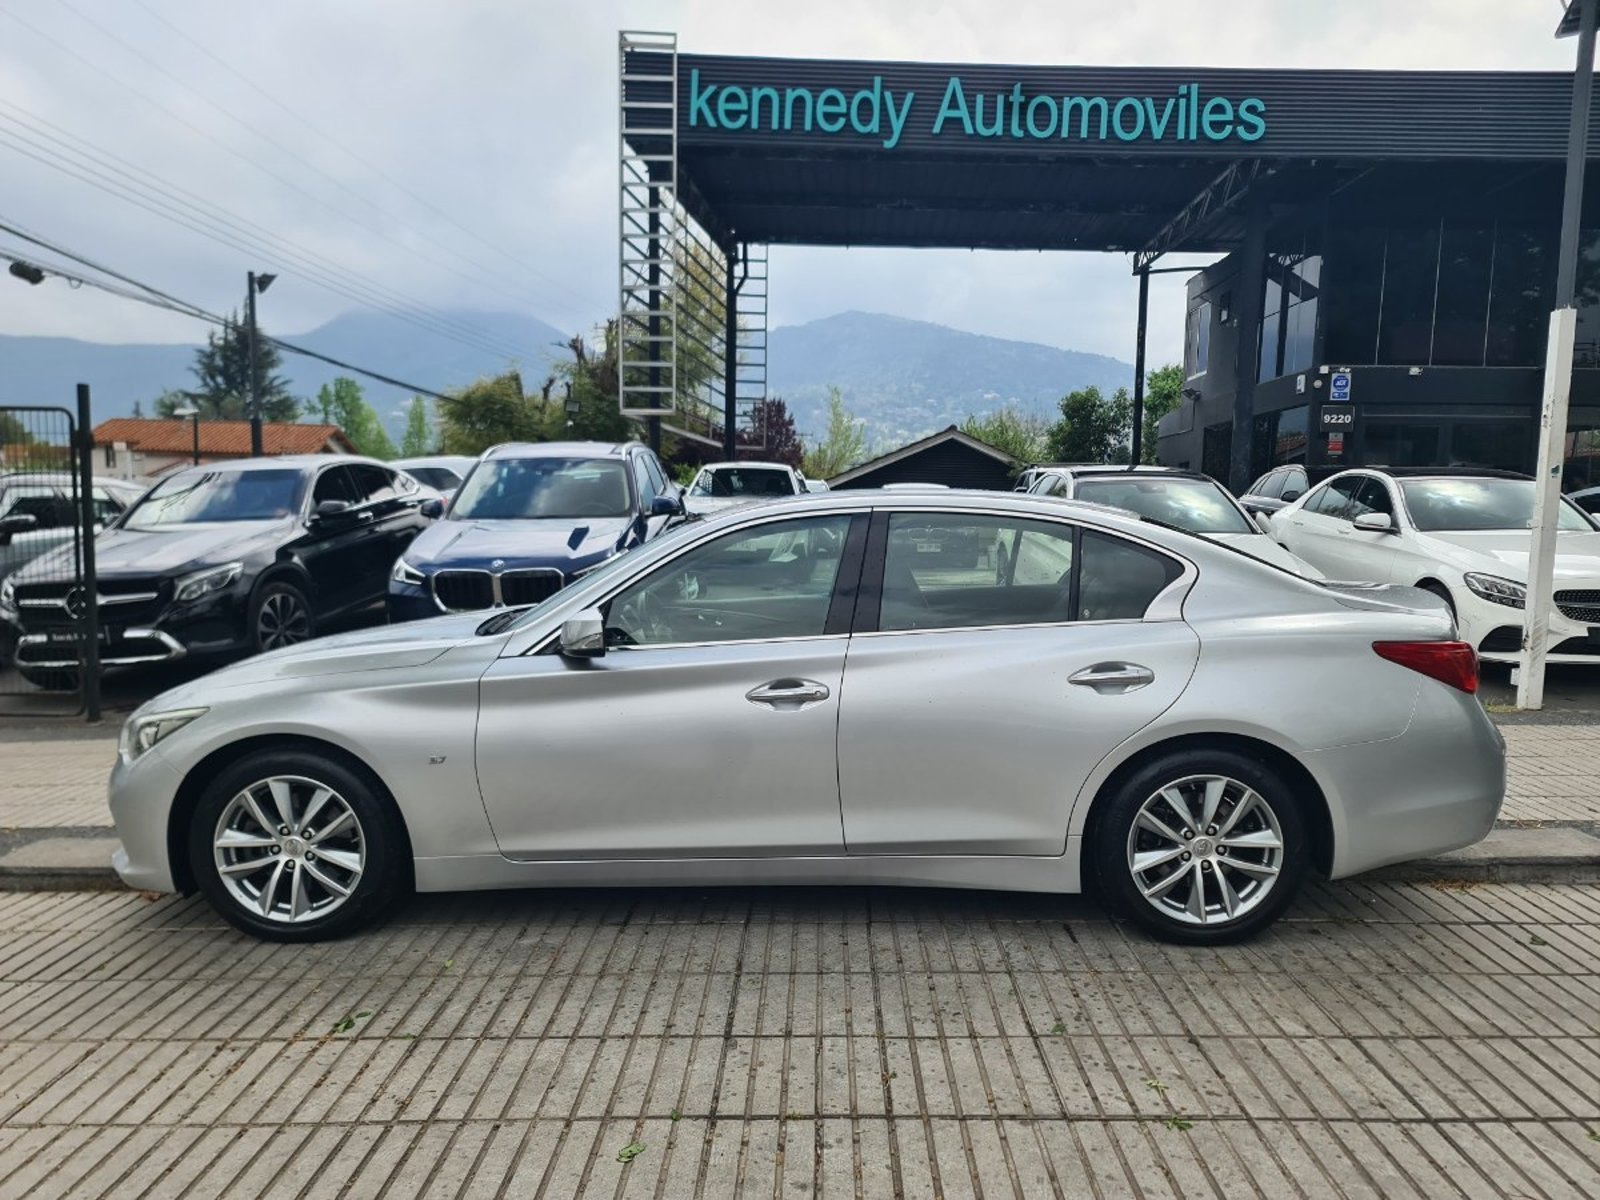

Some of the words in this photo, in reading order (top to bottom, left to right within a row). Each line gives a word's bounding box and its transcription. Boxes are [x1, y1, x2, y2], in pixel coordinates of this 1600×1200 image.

[689, 68, 915, 149] kennedy
[932, 77, 1266, 141] Automoviles
[1323, 414, 1352, 424] 9220
